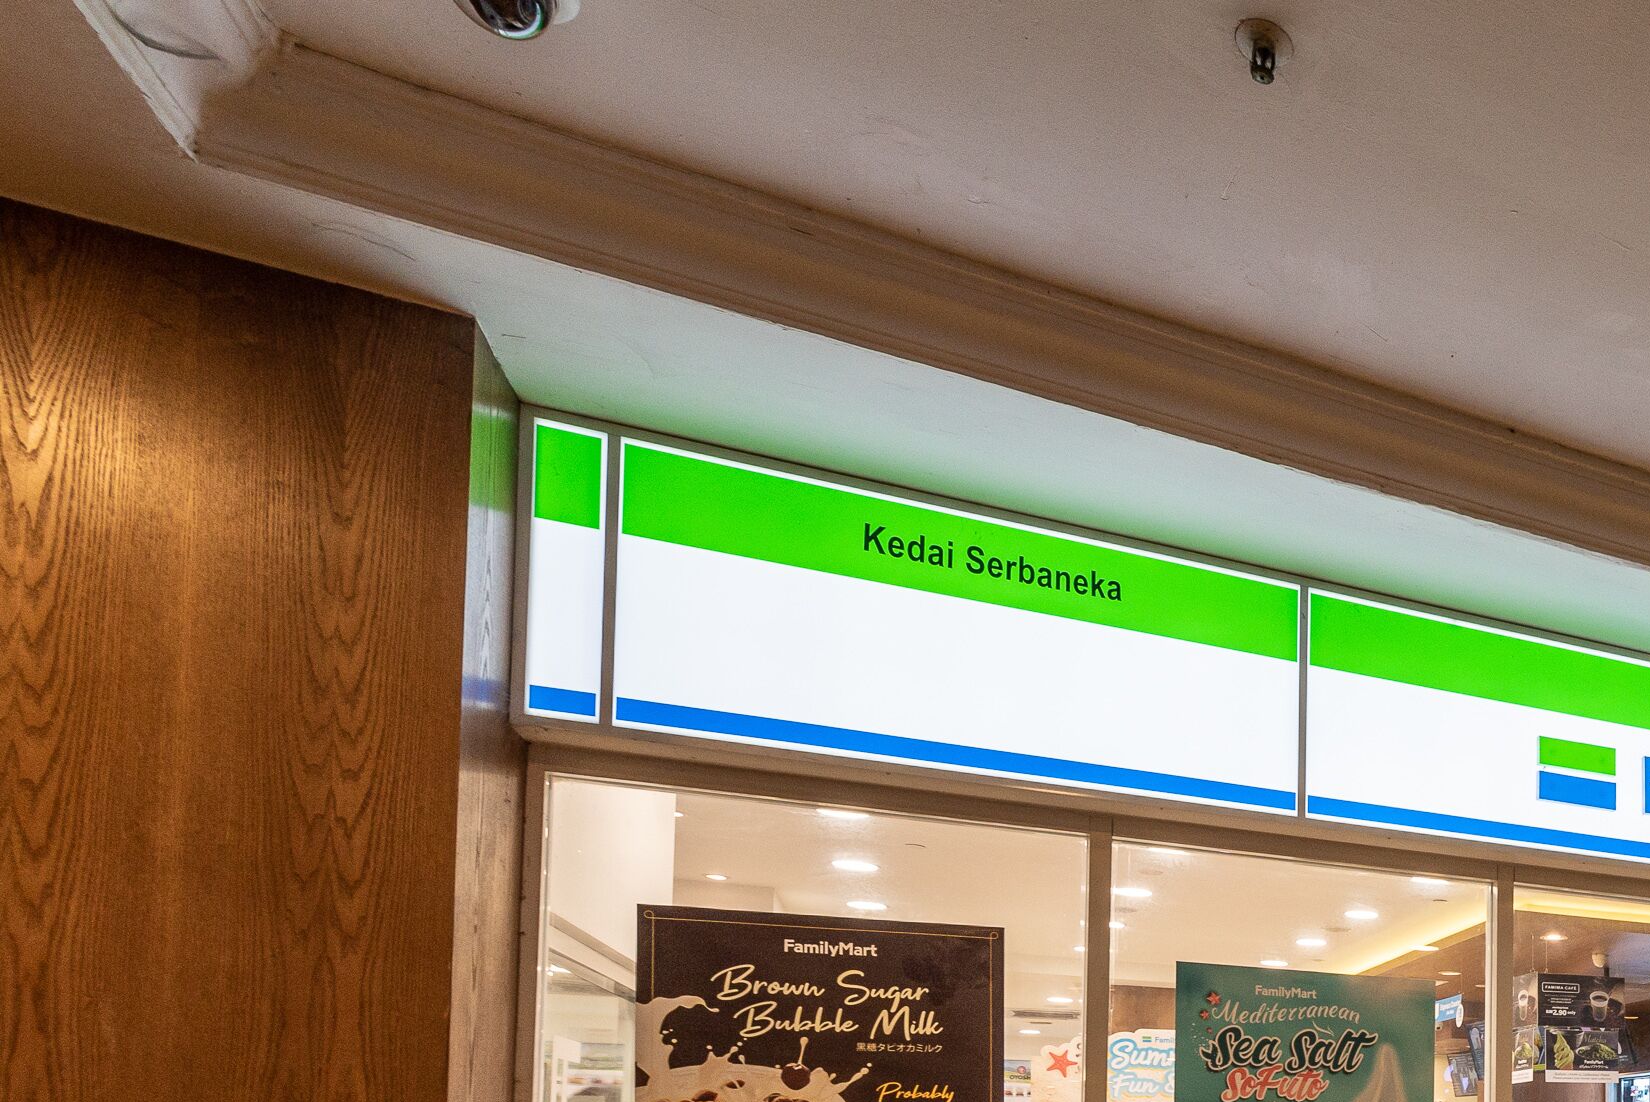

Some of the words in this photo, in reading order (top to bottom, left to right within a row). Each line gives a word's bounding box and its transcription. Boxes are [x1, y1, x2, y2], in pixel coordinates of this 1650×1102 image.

[863, 522, 954, 569] Kedai
[965, 545, 1122, 602] Serbaneka
[783, 938, 878, 958] FamilyMart
[710, 964, 825, 1001] Brown
[836, 970, 929, 1013] Sugar
[1255, 984, 1317, 999] FamilyMart
[733, 1000, 859, 1038] Bubble
[870, 1005, 944, 1041] Milk
[1212, 1000, 1360, 1025] Mediterranean
[1200, 1025, 1282, 1071] Sea
[1285, 1028, 1378, 1074] Salt
[1112, 1074, 1158, 1098] Fun
